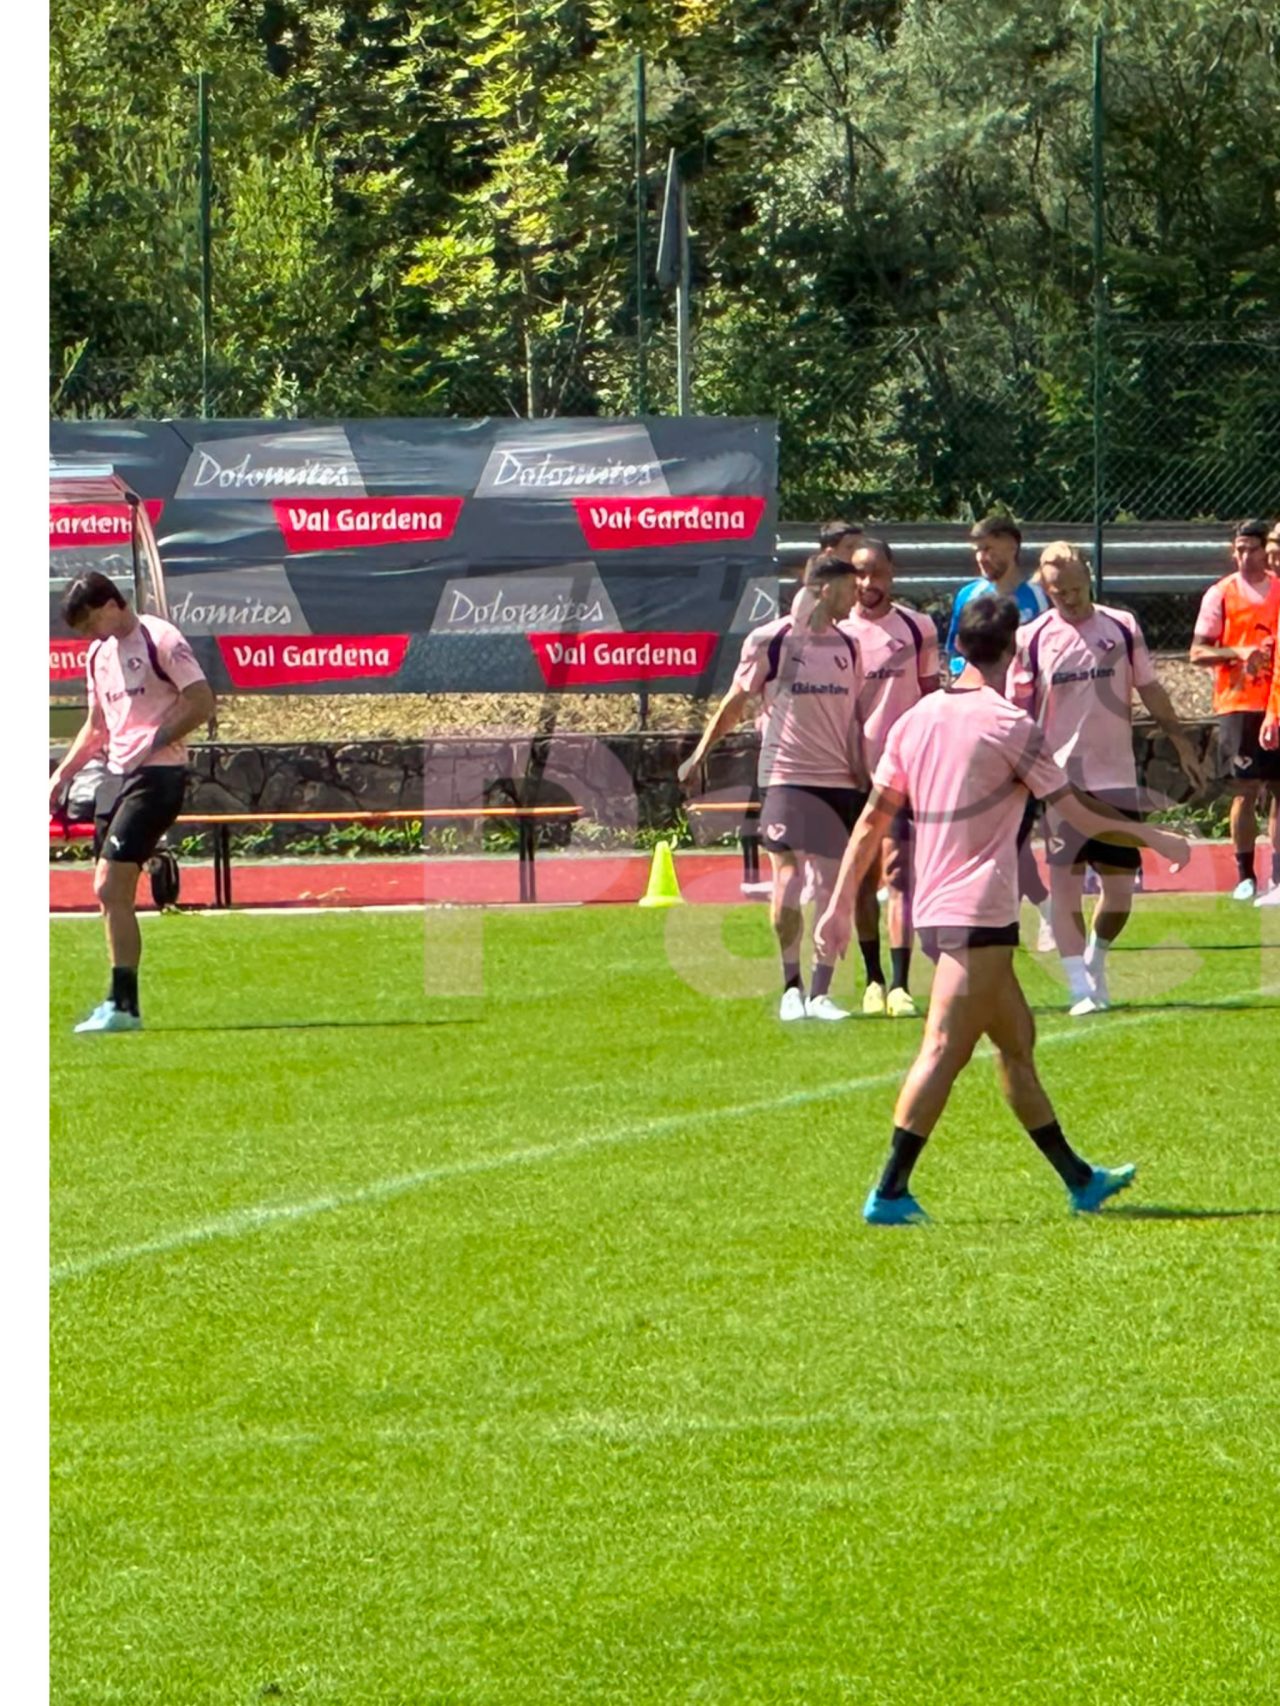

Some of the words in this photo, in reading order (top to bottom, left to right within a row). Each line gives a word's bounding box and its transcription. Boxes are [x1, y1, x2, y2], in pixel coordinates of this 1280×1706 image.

[193, 451, 350, 488] Dolomites
[288, 508, 330, 532] Val
[336, 508, 443, 531] Gardena
[589, 507, 632, 529] Val
[637, 506, 746, 530] Gardena
[447, 588, 605, 624] Dolomites
[232, 646, 275, 668] Val
[282, 643, 390, 668] Gardena
[545, 643, 586, 666] Val
[593, 642, 698, 667] Gardena
